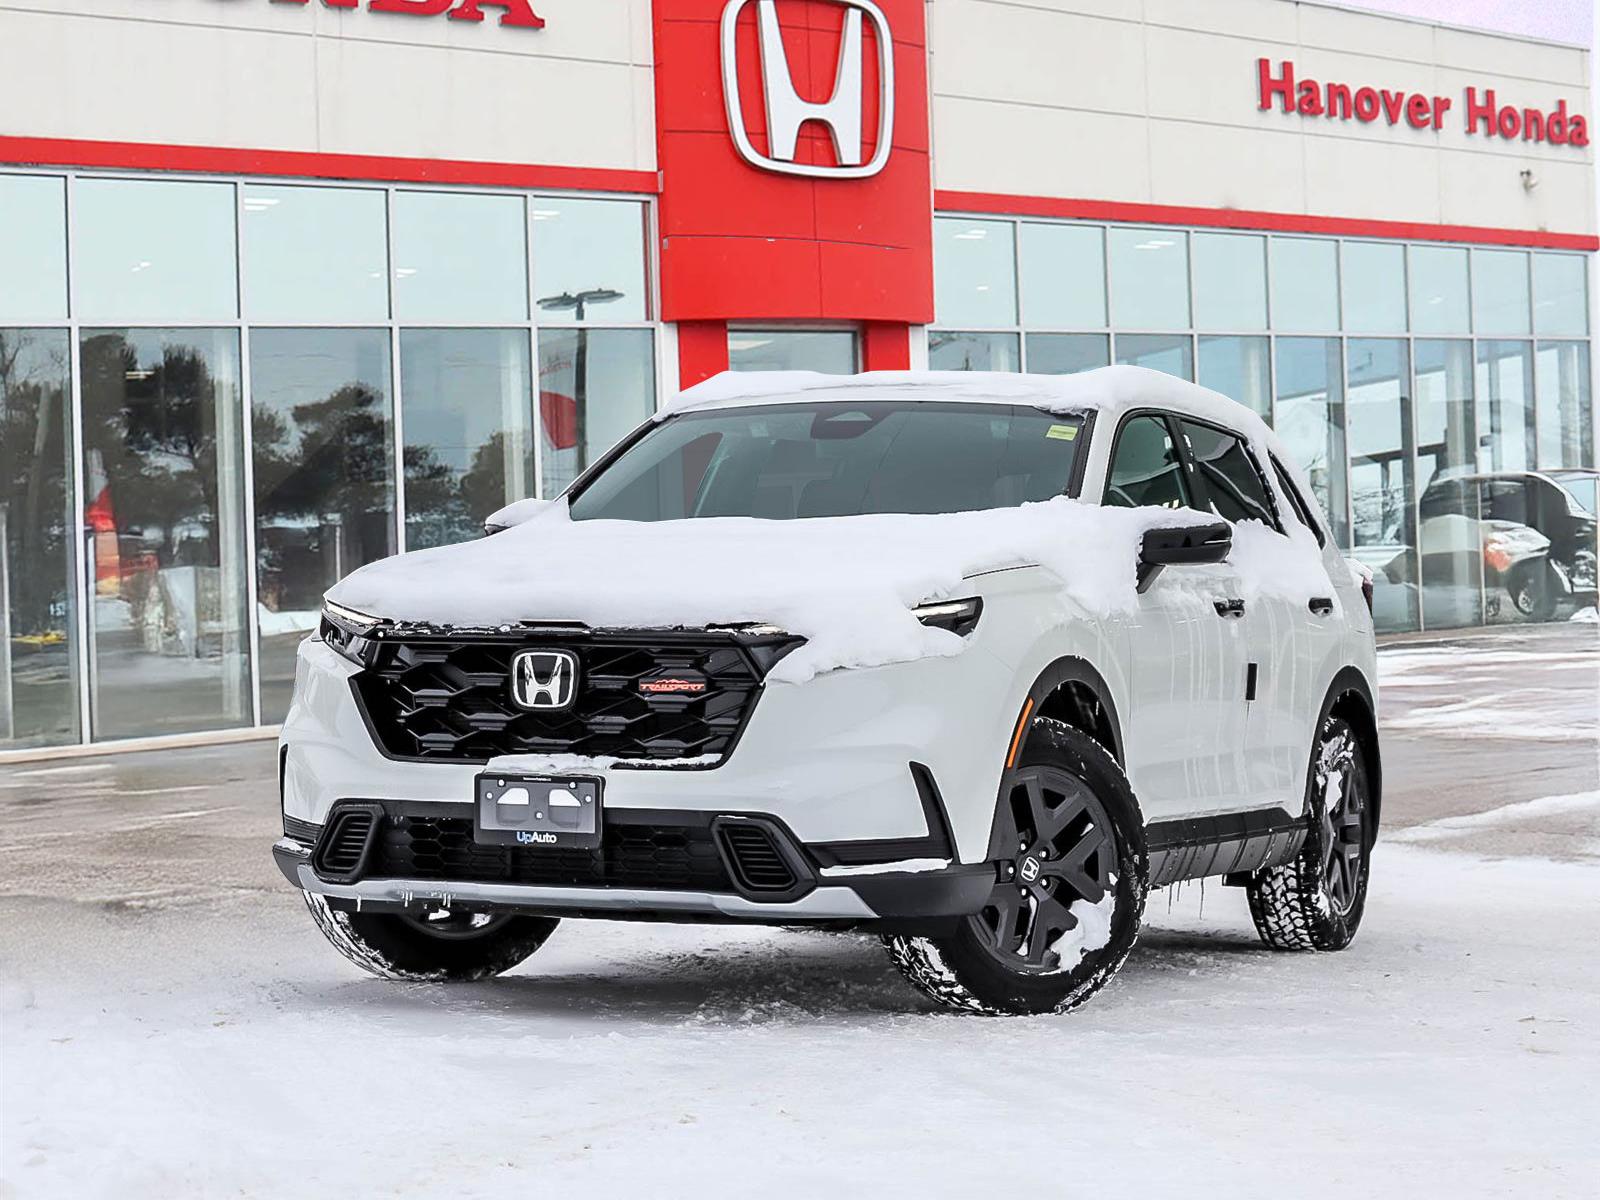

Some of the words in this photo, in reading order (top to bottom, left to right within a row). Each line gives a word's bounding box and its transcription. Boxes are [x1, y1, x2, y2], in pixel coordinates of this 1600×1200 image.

[1256, 57, 1452, 131] Hanover
[1465, 86, 1590, 148] Honda
[640, 683, 705, 691] TRAILSPORT
[516, 831, 557, 845] UpAuto
